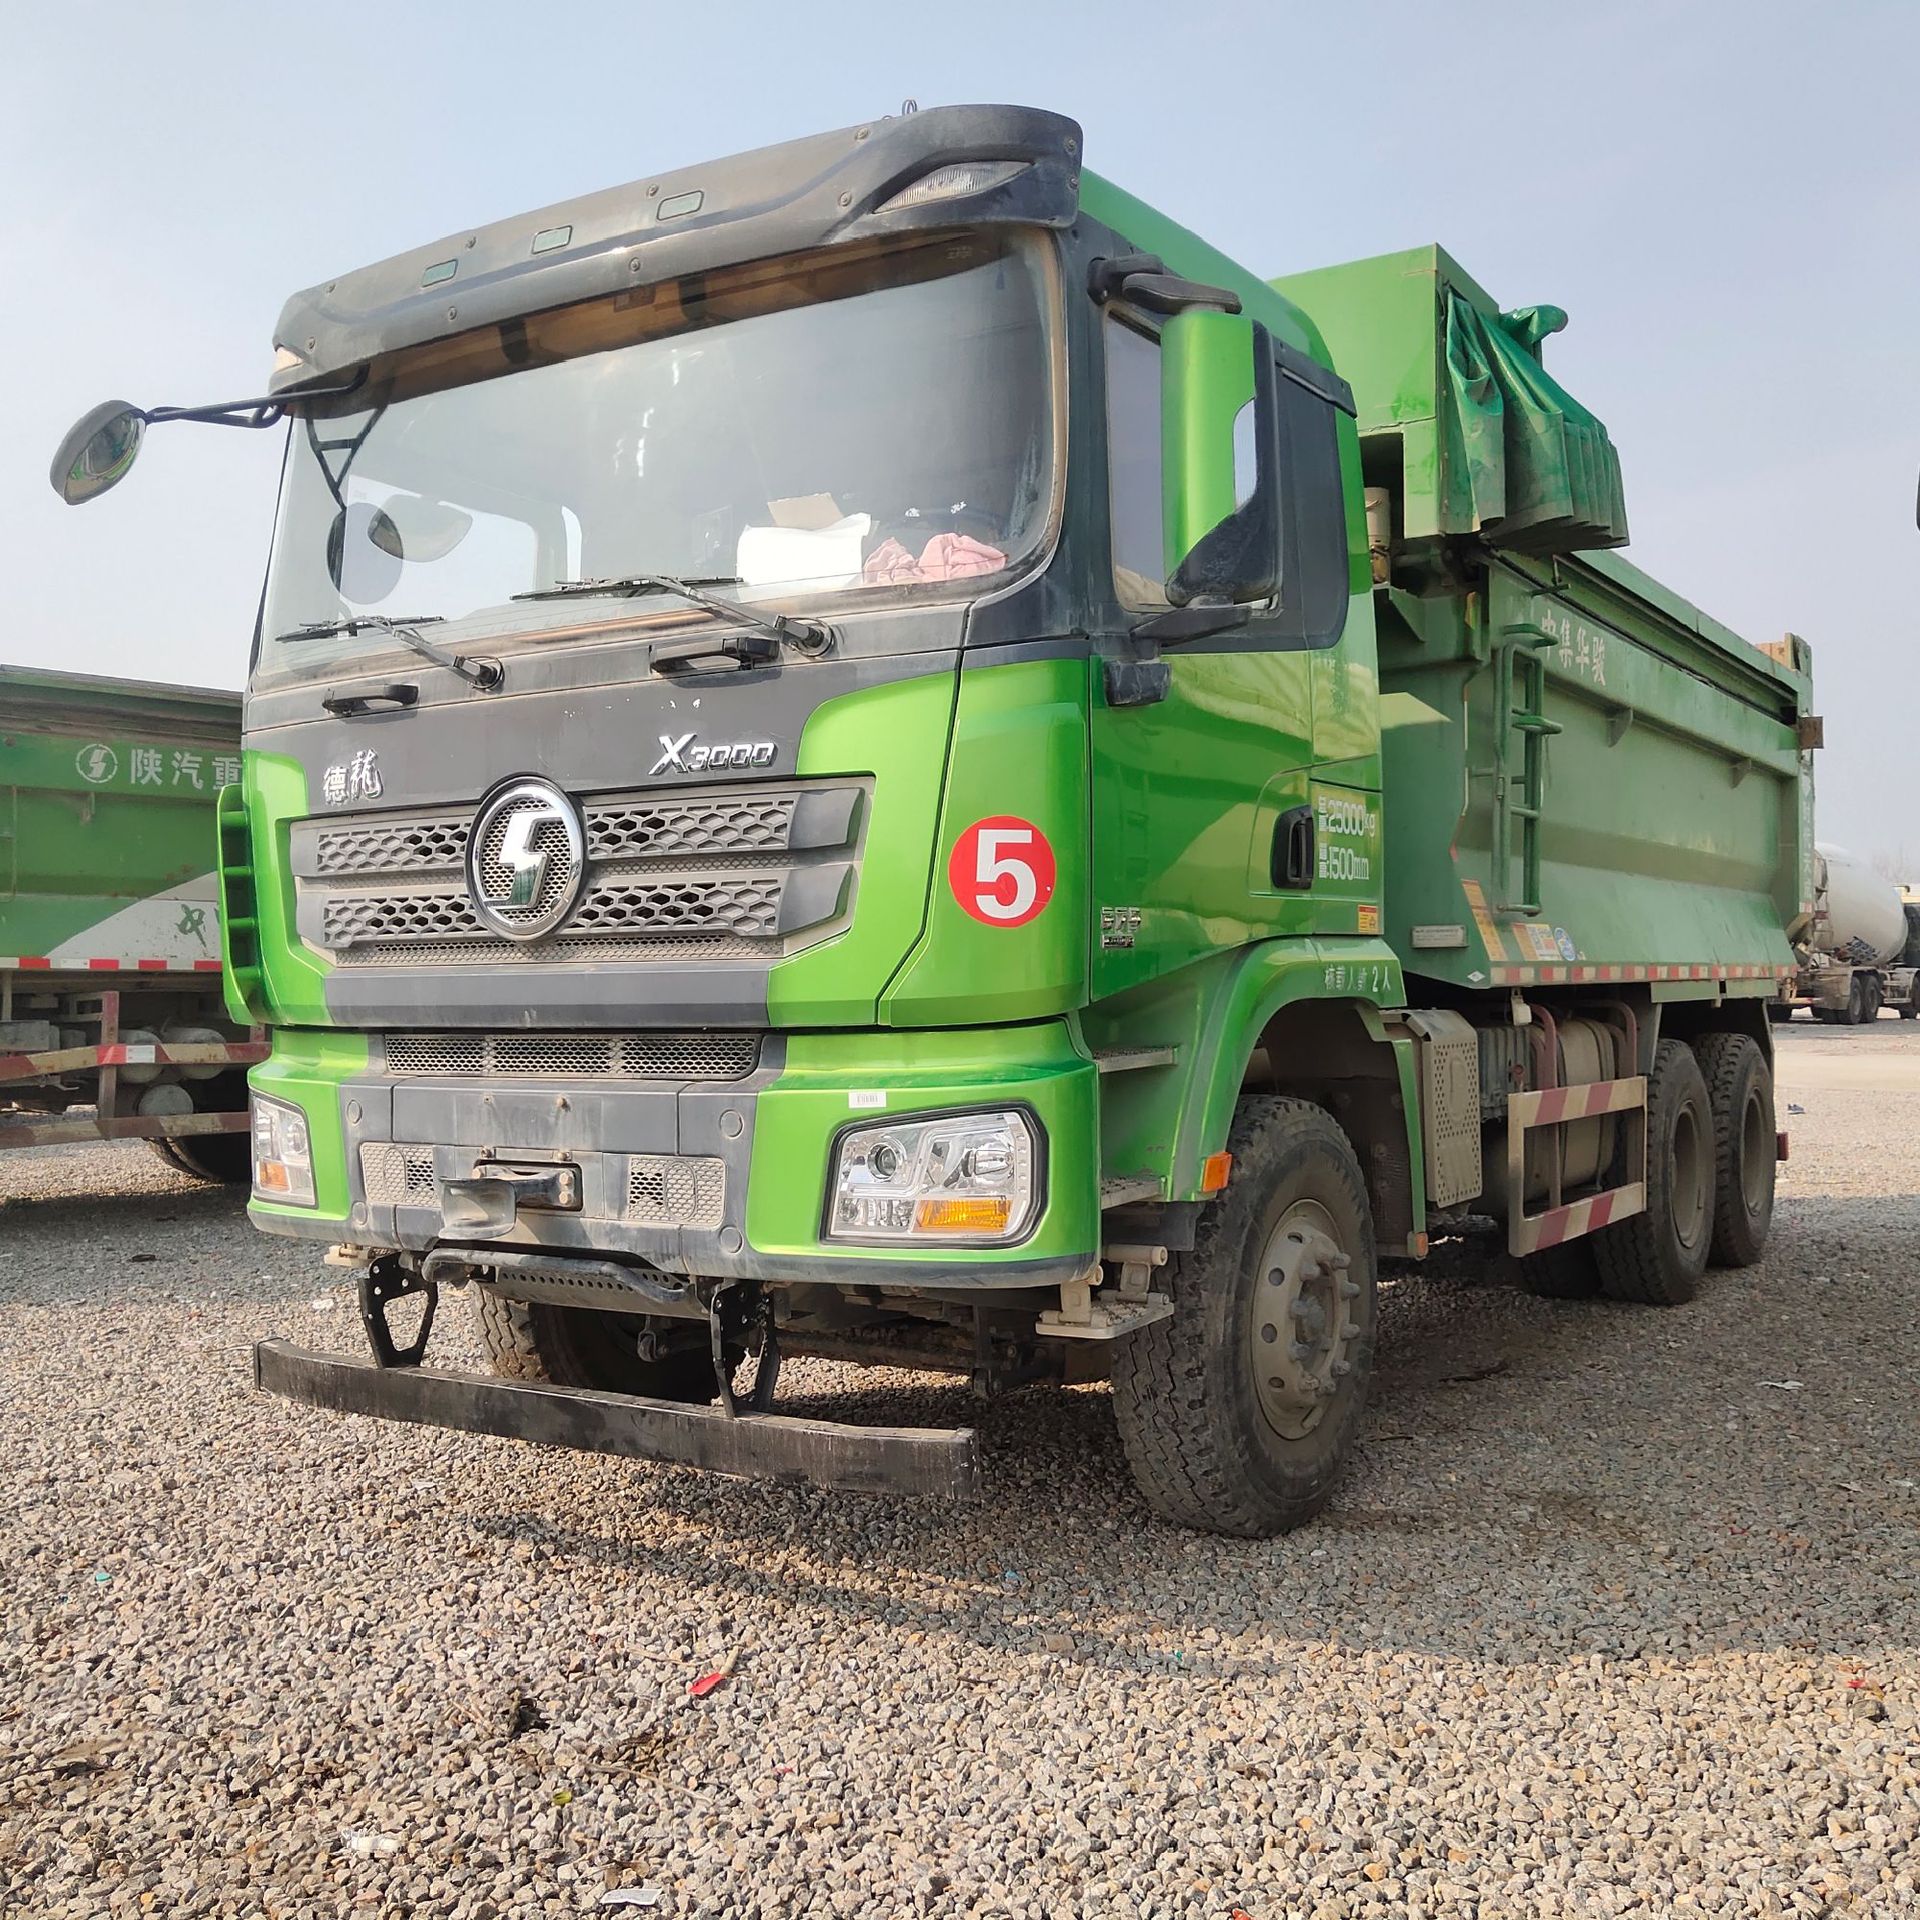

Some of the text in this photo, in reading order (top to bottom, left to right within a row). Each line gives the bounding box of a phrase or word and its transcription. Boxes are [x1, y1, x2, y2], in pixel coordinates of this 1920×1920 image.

[1541, 608, 1606, 686] 中集华骏
[648, 732, 777, 775] X3000
[975, 828, 1037, 919] 5
